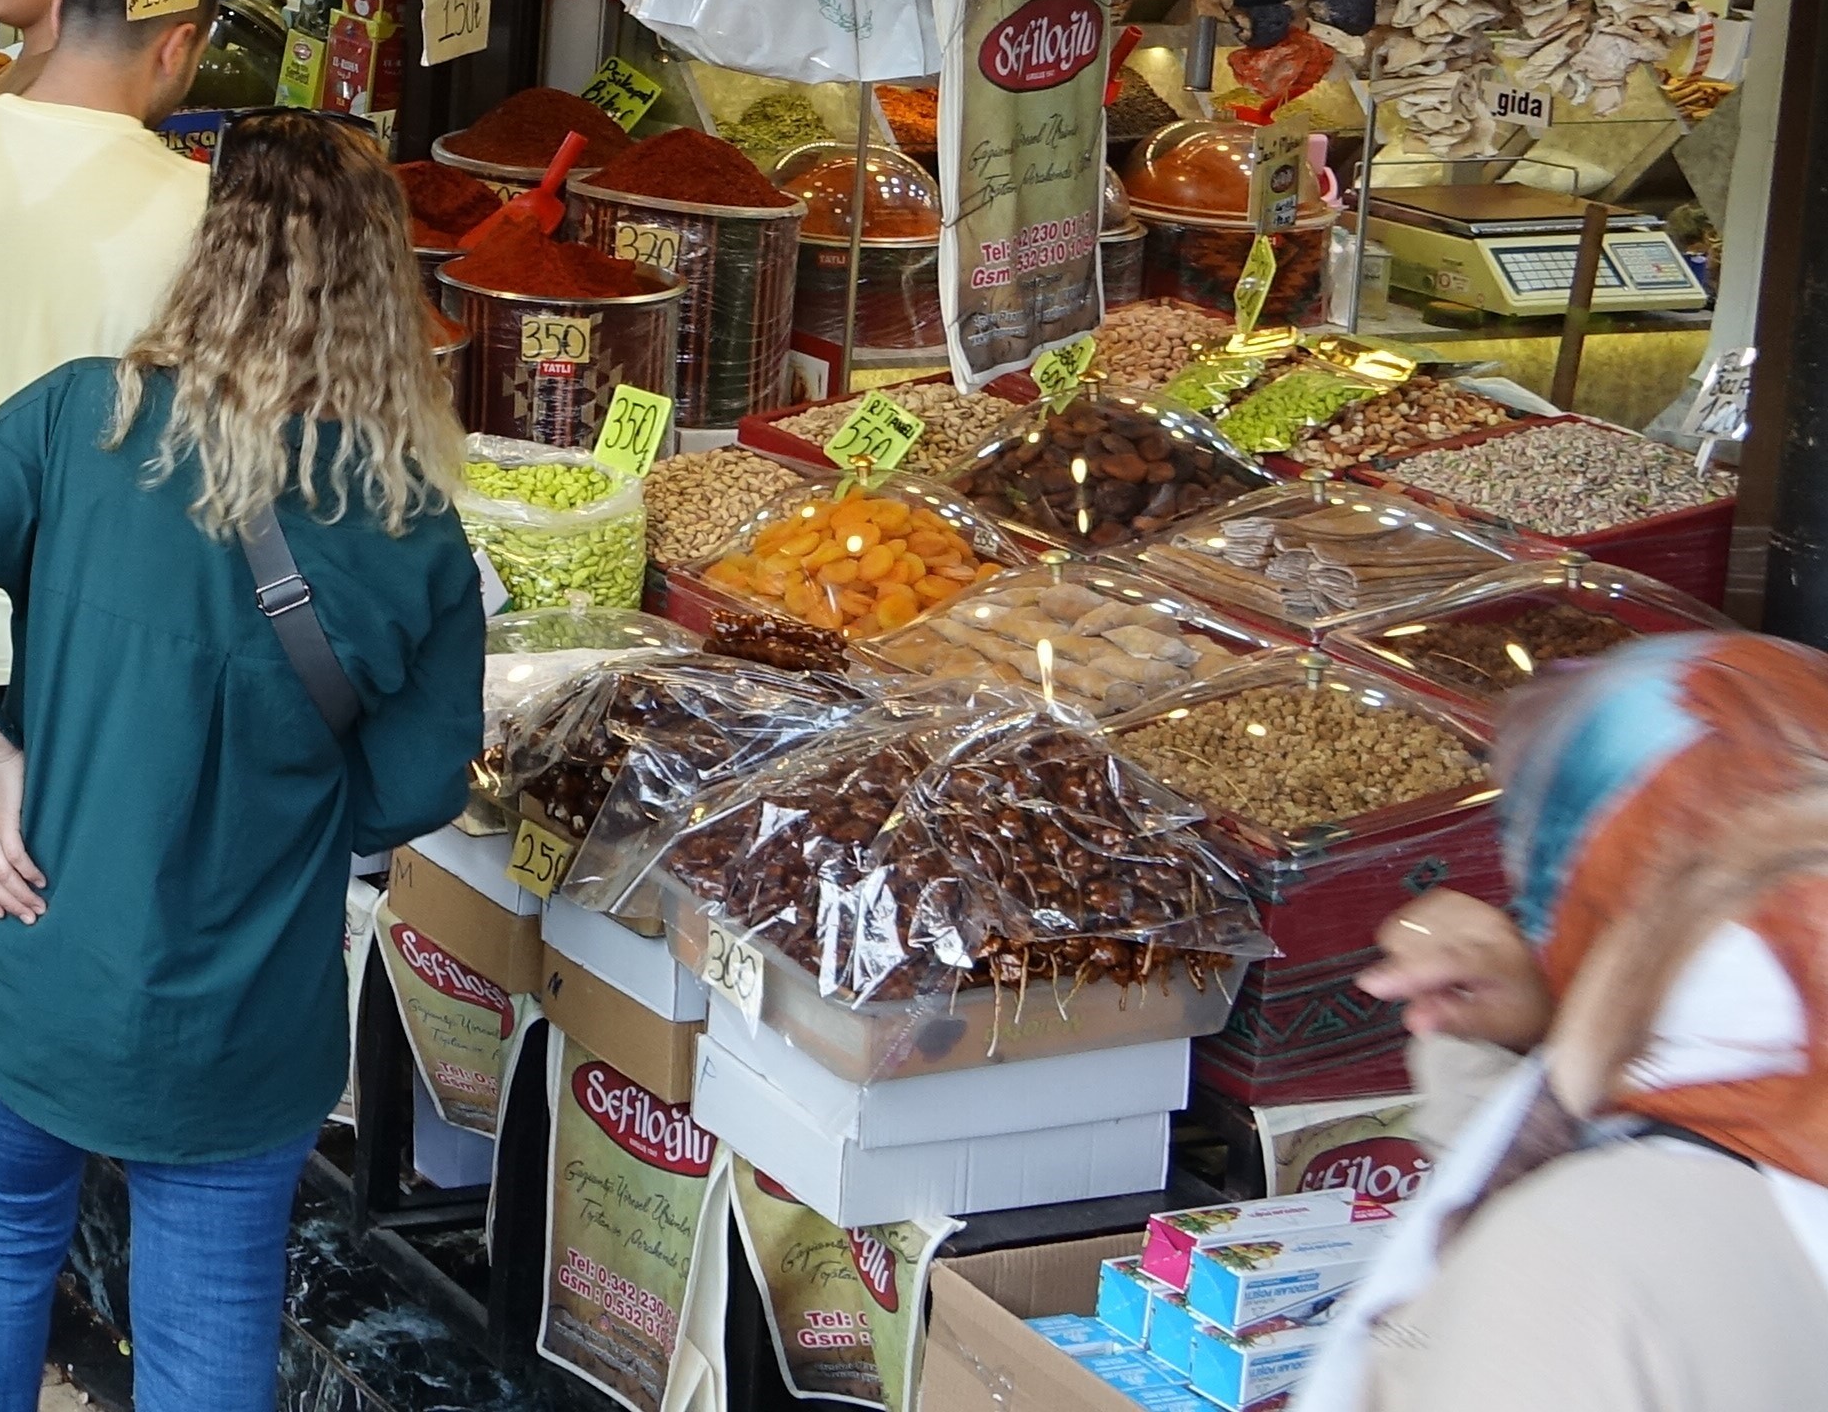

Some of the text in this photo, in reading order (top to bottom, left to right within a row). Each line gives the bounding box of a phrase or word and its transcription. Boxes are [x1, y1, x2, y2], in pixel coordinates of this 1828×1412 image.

[995, 10, 1098, 79] Sefiloğlu
[981, 240, 1011, 263] Tel:
[1031, 222, 1058, 245] 230
[1039, 242, 1066, 266] 310
[542, 362, 571, 374] TATLI
[394, 856, 413, 889] M
[586, 1069, 710, 1164] Sefiloğlu
[559, 1266, 592, 1298] Gsm
[603, 1293, 643, 1328] 0.532
[568, 1248, 596, 1278] Tel:
[598, 1267, 637, 1301] 0.342
[640, 1292, 664, 1318] 230
[806, 1311, 852, 1327] Tel:
[798, 1331, 855, 1347] Gsm
